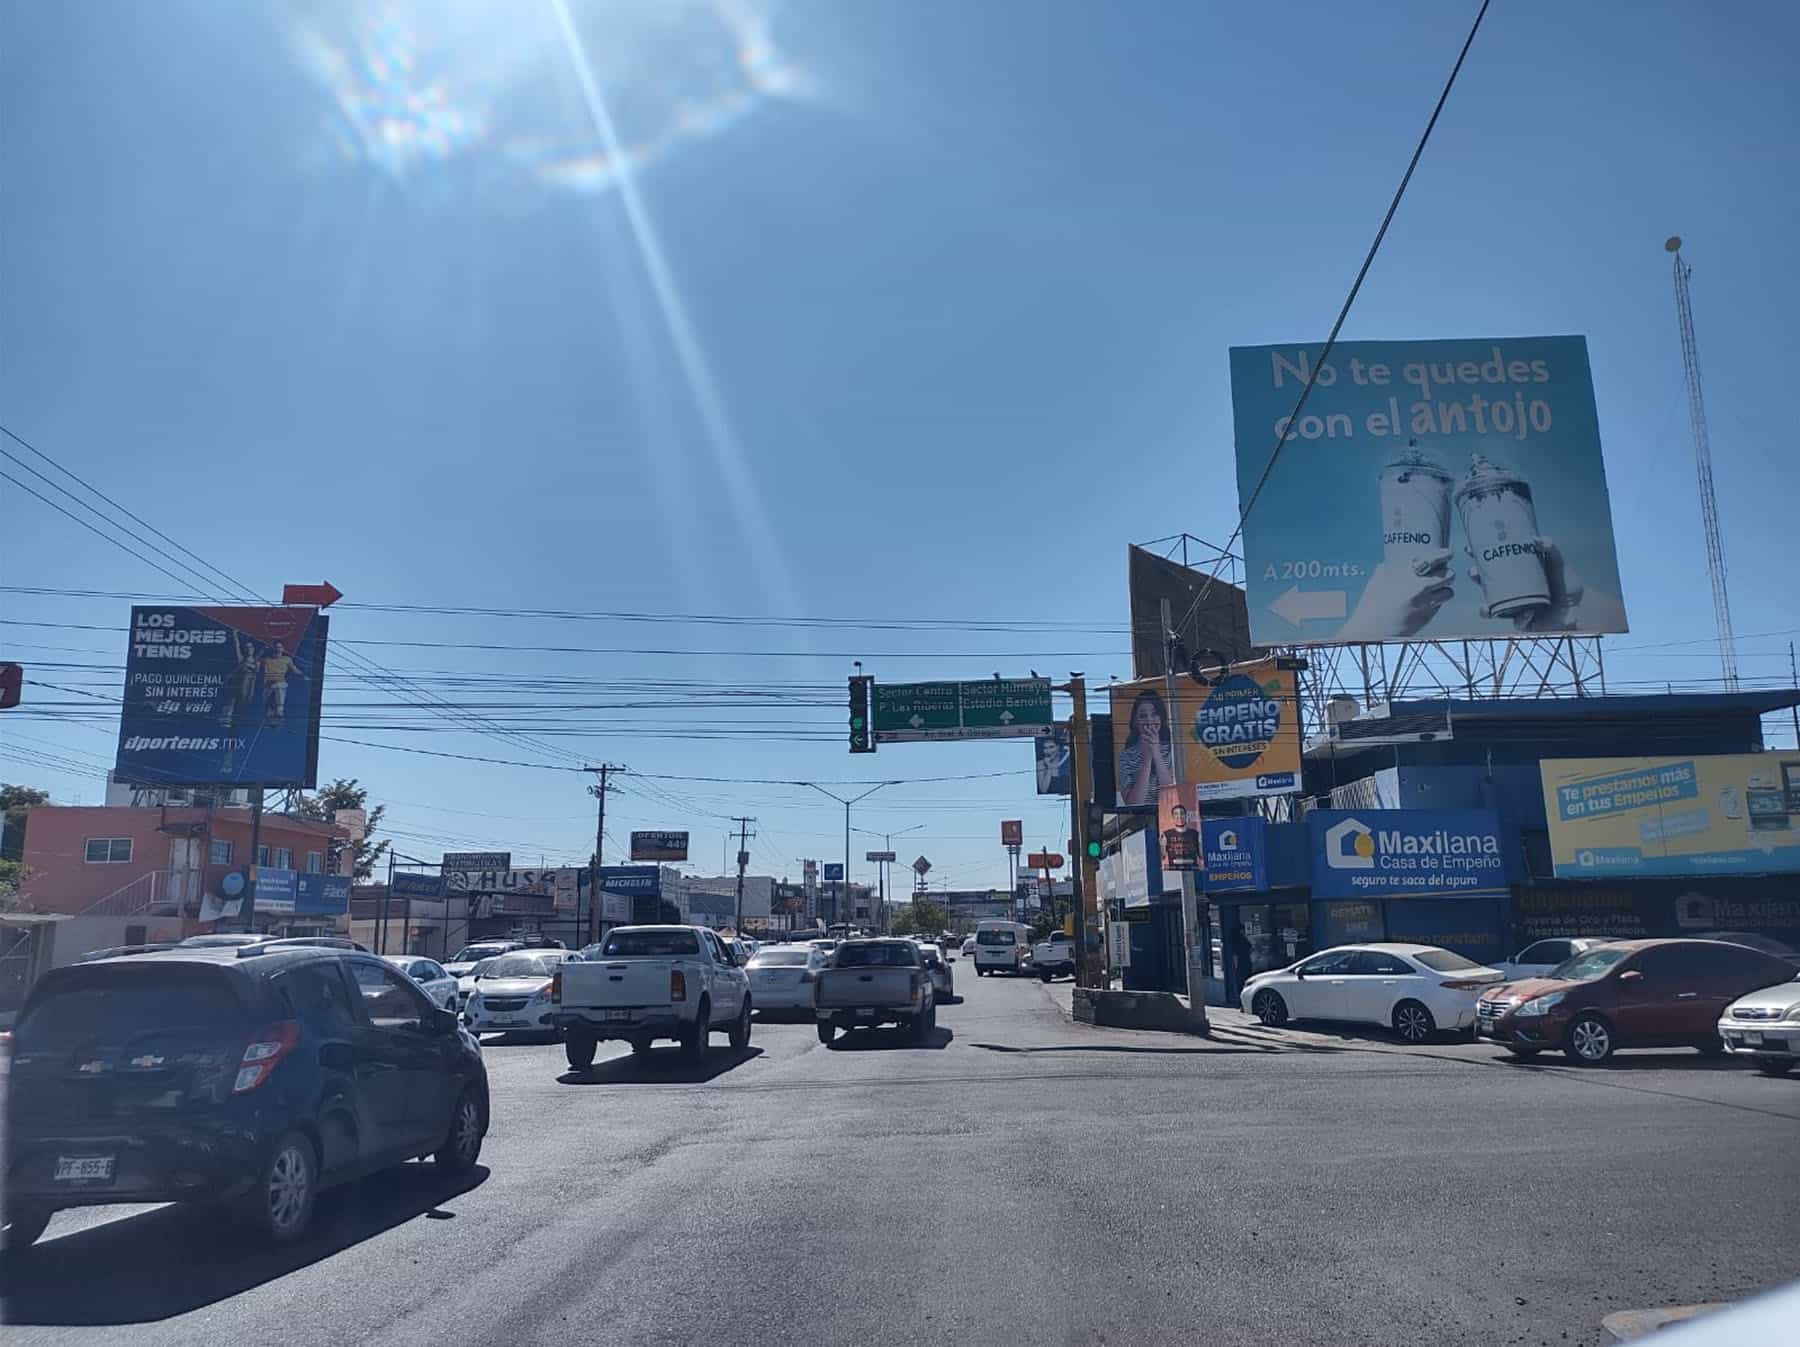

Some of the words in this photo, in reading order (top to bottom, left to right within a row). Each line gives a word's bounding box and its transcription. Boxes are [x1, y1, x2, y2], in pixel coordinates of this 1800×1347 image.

[1271, 350, 1337, 388] No
[1351, 357, 1391, 385] te
[1402, 346, 1550, 400] quedes
[1274, 413, 1353, 441] con
[1366, 396, 1401, 437] el
[1410, 391, 1552, 440] antojo
[1384, 532, 1431, 544] CAFFENIO
[1483, 543, 1537, 562] CAFFENIO
[1264, 564, 1278, 581] A
[136, 613, 176, 628] LOS
[135, 629, 227, 645] MEJORES
[134, 645, 193, 660] TENIS
[164, 673, 224, 687] QUINCENAL
[145, 687, 164, 698] SIN
[879, 687, 912, 700] Sector
[915, 685, 953, 697] Centro
[963, 683, 998, 697] Sector
[962, 697, 1002, 710] Estadio
[1199, 697, 1280, 724] EMPEÑO
[1202, 718, 1277, 744] GRATIS
[124, 735, 246, 751] dportenis.mx
[1563, 788, 1580, 801] Te
[1583, 774, 1658, 801] prestamos
[1660, 767, 1692, 784] más
[1567, 802, 1585, 816] en
[1589, 797, 1612, 812] tus
[1379, 831, 1499, 855] Maxilana
[1208, 851, 1252, 862] Maxilana
[1380, 856, 1416, 869] Casa
[1421, 856, 1438, 869] de
[1443, 855, 1501, 871] Empeño
[1209, 871, 1252, 881] EMPEÑOS
[1352, 876, 1387, 888] seguro
[1389, 874, 1400, 885] te
[1428, 874, 1444, 885] del
[605, 880, 652, 888] MICHELIN
